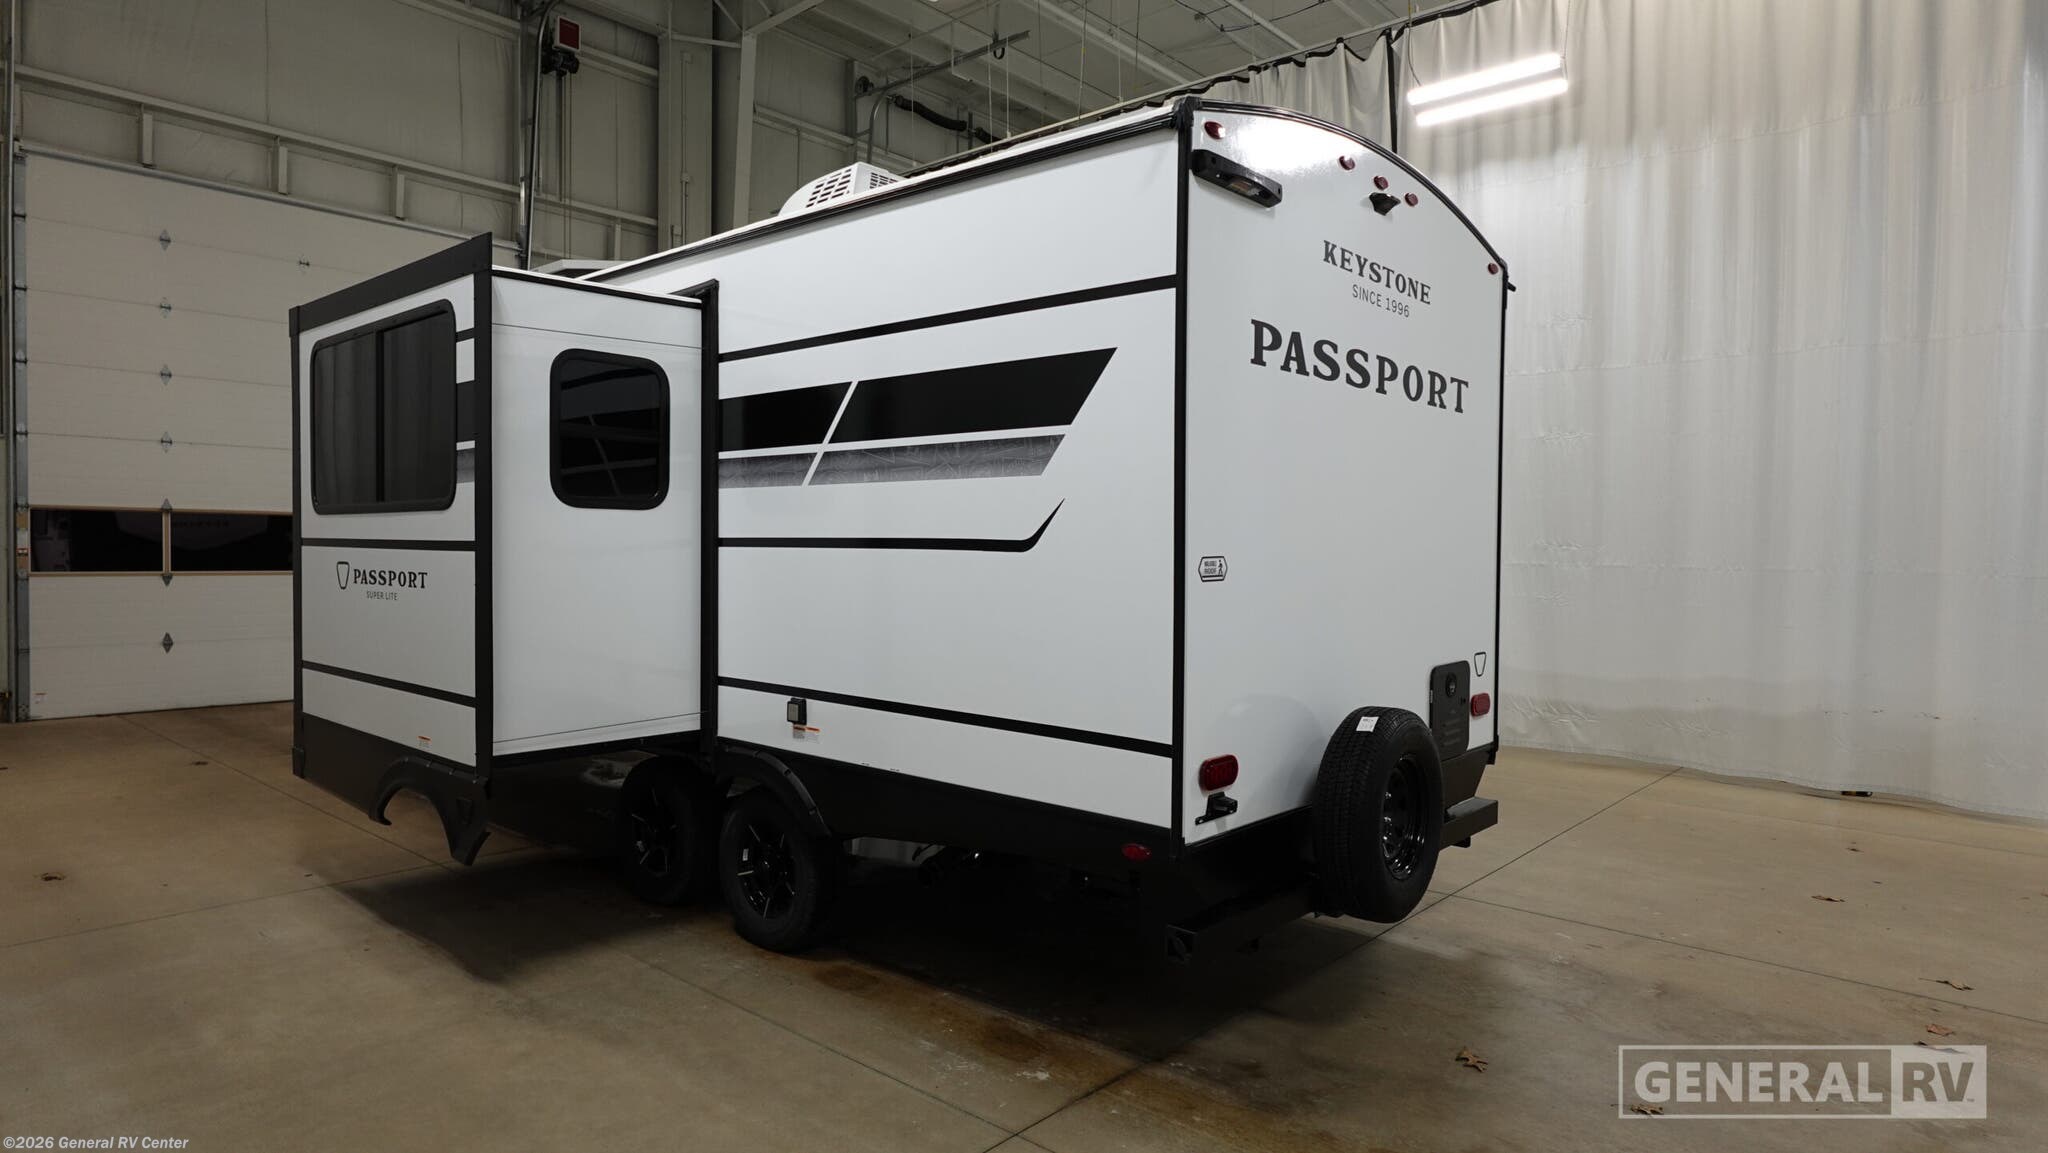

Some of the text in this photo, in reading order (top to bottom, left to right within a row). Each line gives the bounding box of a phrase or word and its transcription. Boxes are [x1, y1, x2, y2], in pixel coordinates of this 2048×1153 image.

[1323, 239, 1431, 305] KEYSTONE
[1352, 284, 1410, 318] SINCE 1996
[1250, 318, 1469, 414] PASSPORT
[353, 568, 428, 589] PASSPORT
[366, 590, 398, 601] SUPER LITE
